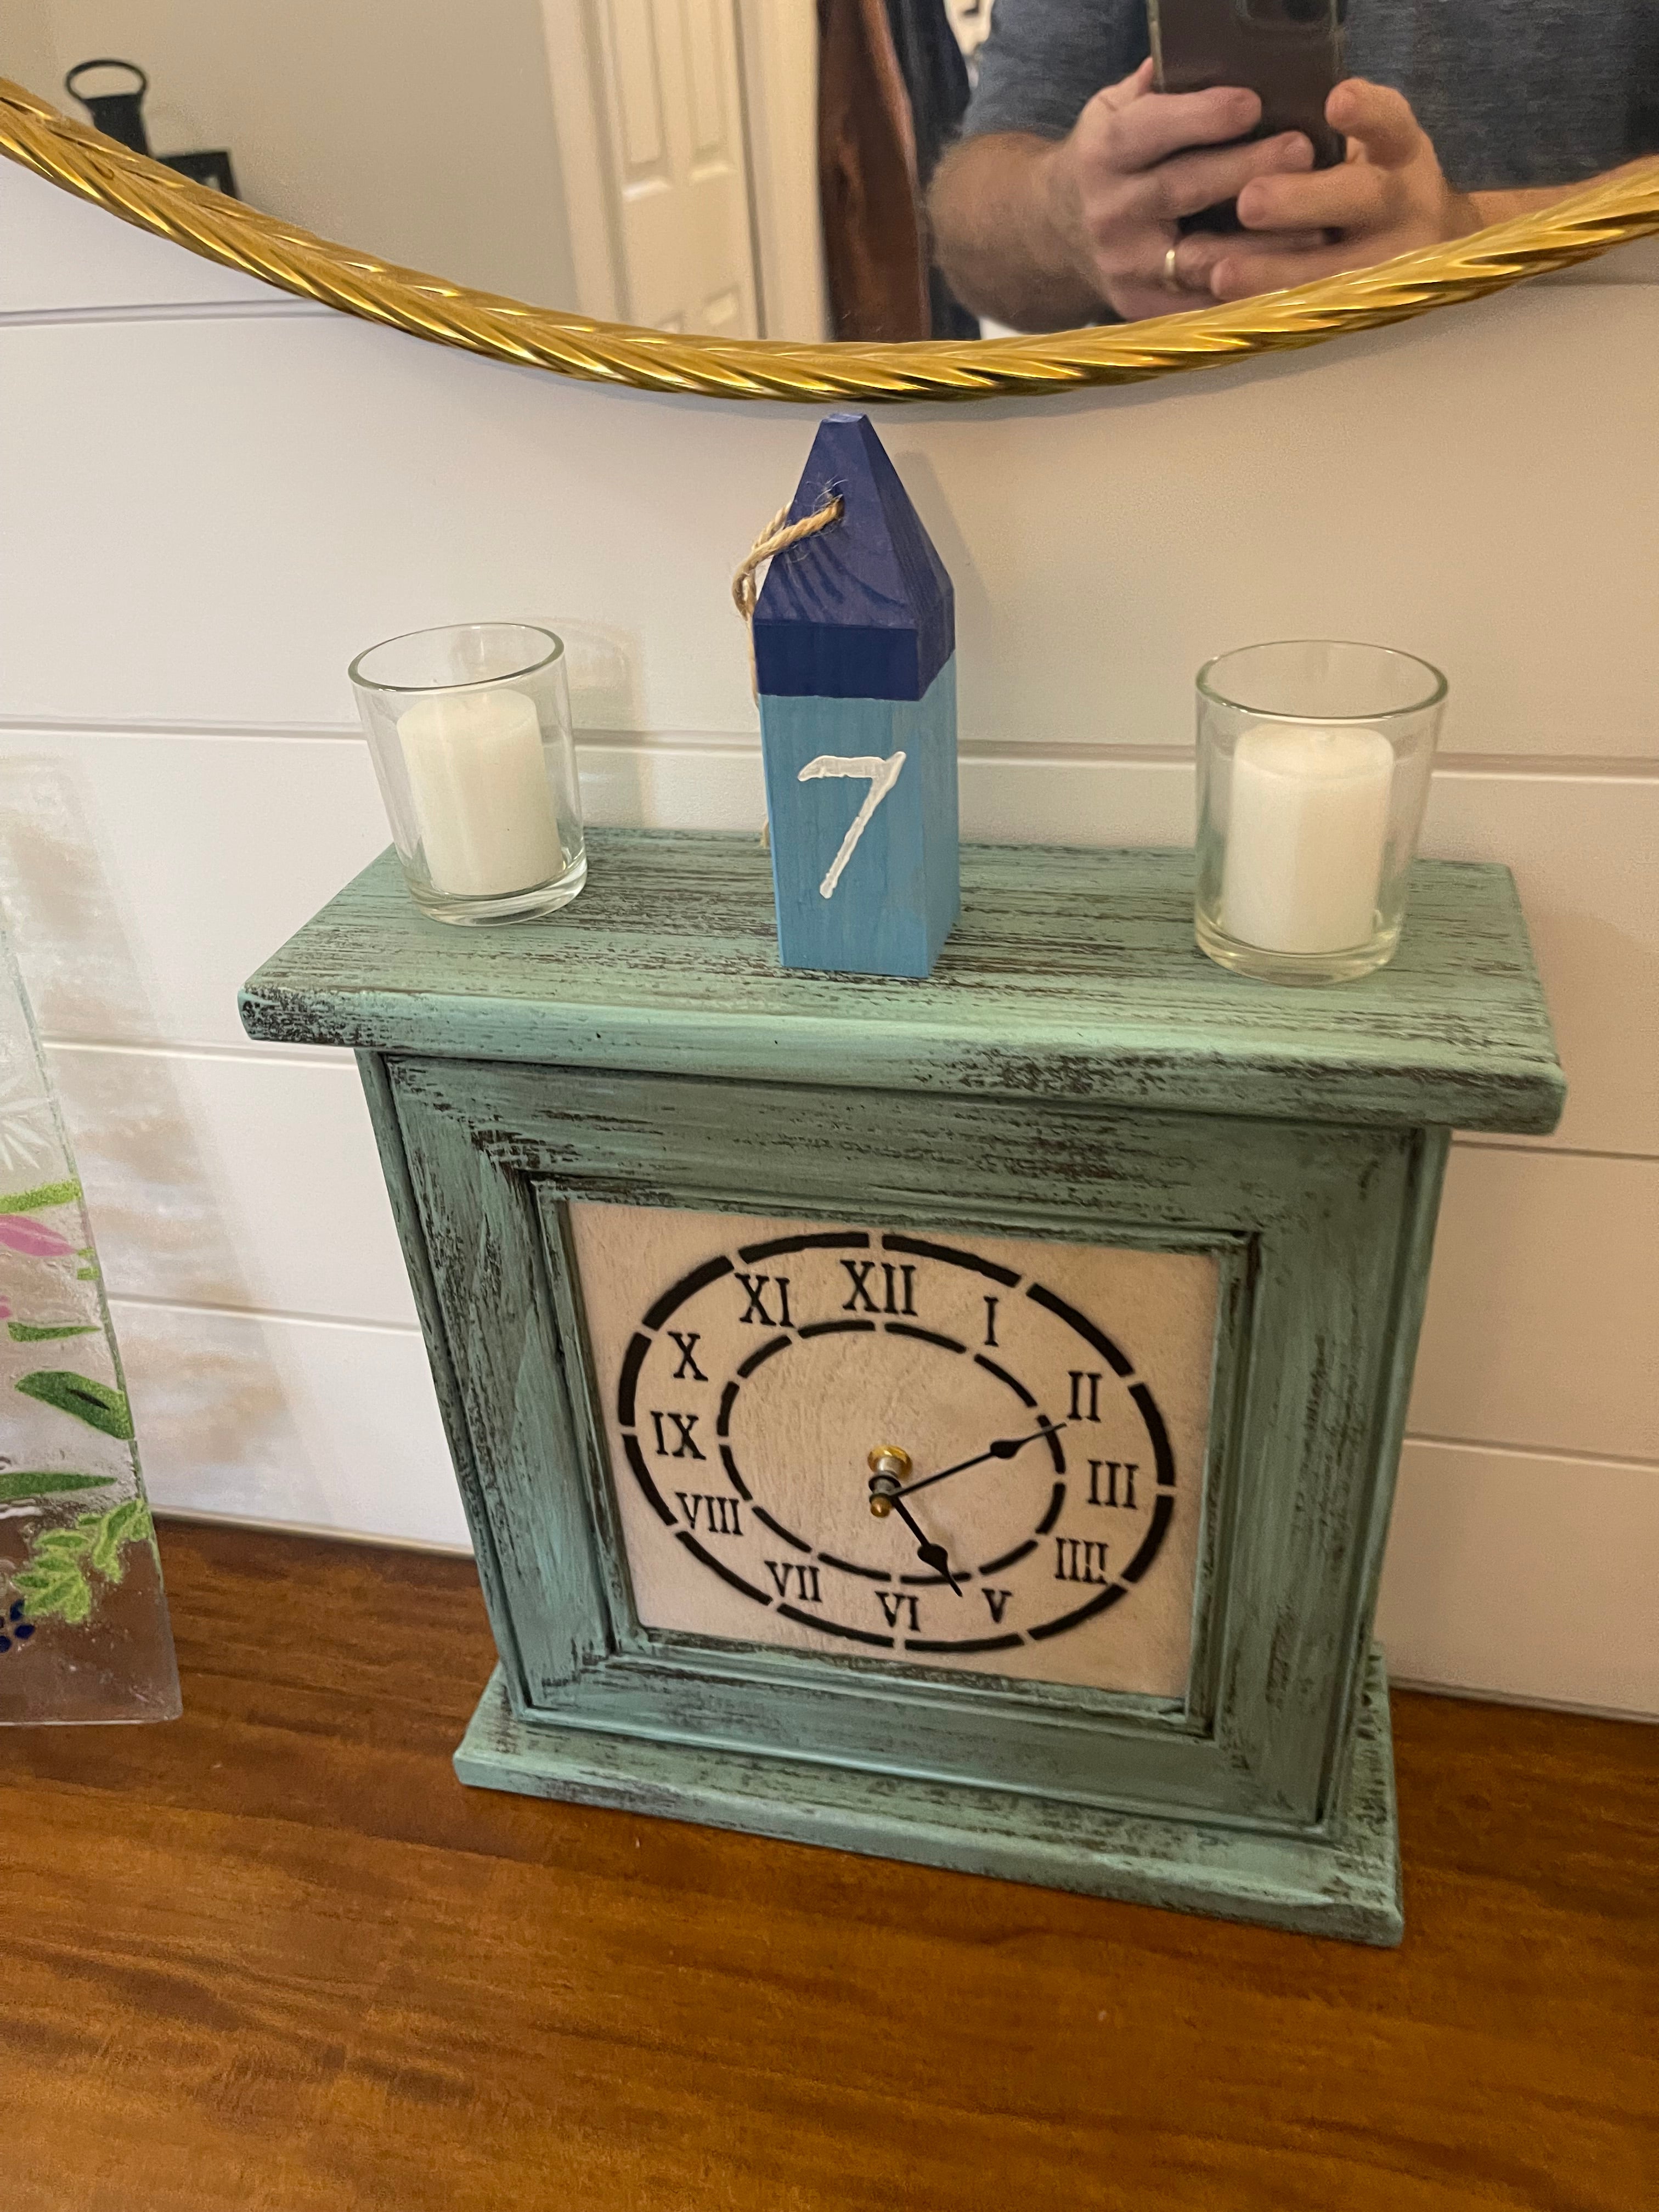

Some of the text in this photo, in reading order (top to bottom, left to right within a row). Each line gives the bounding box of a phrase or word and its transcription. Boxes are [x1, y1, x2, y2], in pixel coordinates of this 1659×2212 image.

[798, 751, 906, 899] 7
[735, 1273, 795, 1328] XI
[840, 1259, 917, 1316] XII
[983, 1296, 1000, 1347] I
[668, 1331, 708, 1381] X
[1068, 1371, 1102, 1422] II
[651, 1411, 706, 1460] IX
[1087, 1460, 1141, 1509] III
[675, 1492, 744, 1536] VIII
[764, 1560, 823, 1603] VII
[1054, 1537, 1108, 1583] IIII
[876, 1593, 921, 1632] VI
[982, 1589, 1012, 1623] V
